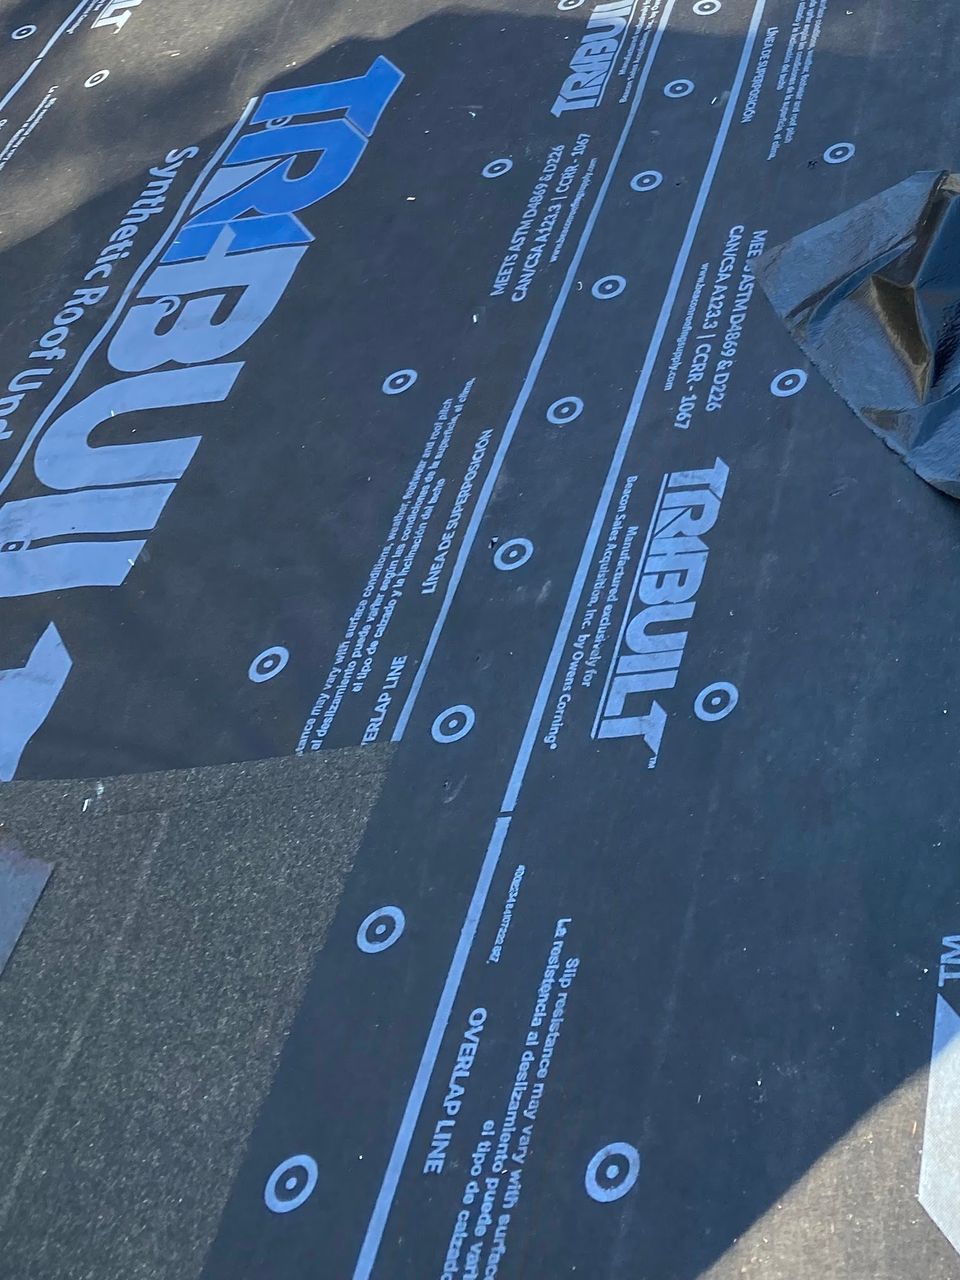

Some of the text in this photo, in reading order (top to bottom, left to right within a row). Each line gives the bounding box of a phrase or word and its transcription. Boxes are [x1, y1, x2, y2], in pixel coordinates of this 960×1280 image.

[28, 145, 200, 360] Synthetic Roof
[490, 144, 566, 298] MEETS ASTM D4869 & D226
[511, 133, 592, 302] CAN/CSA A123.3 CCRR 1067
[674, 225, 745, 430] CAN/CSA A123.3 CCRR 1067
[705, 274, 756, 412] ASTM D4869 & D226
[310, 692, 331, 716] may
[322, 666, 342, 691] vary
[334, 640, 351, 666] with
[345, 598, 369, 639] surface
[402, 459, 428, 500] footwear
[421, 444, 434, 460] and
[421, 428, 495, 595] LÍNEA DE SUPERPOSICIÓN
[562, 474, 639, 695] Beacon Sales Acquisition, Inc. by Owens
[351, 623, 372, 659] puede
[379, 560, 399, 593] según
[356, 657, 374, 680] tipo
[366, 639, 380, 656] de
[373, 598, 398, 639] calzado
[383, 654, 409, 690] LINE
[580, 524, 640, 689] Manufactured exclusively for
[596, 456, 731, 757] TRIBUILT
[423, 1006, 488, 1175] OVERLAP LINE
[474, 917, 573, 1238] La resistencia al deslizamiento puede
[502, 956, 581, 1209] Slip resistance may vary with
[462, 1119, 496, 1206] el tipo de
